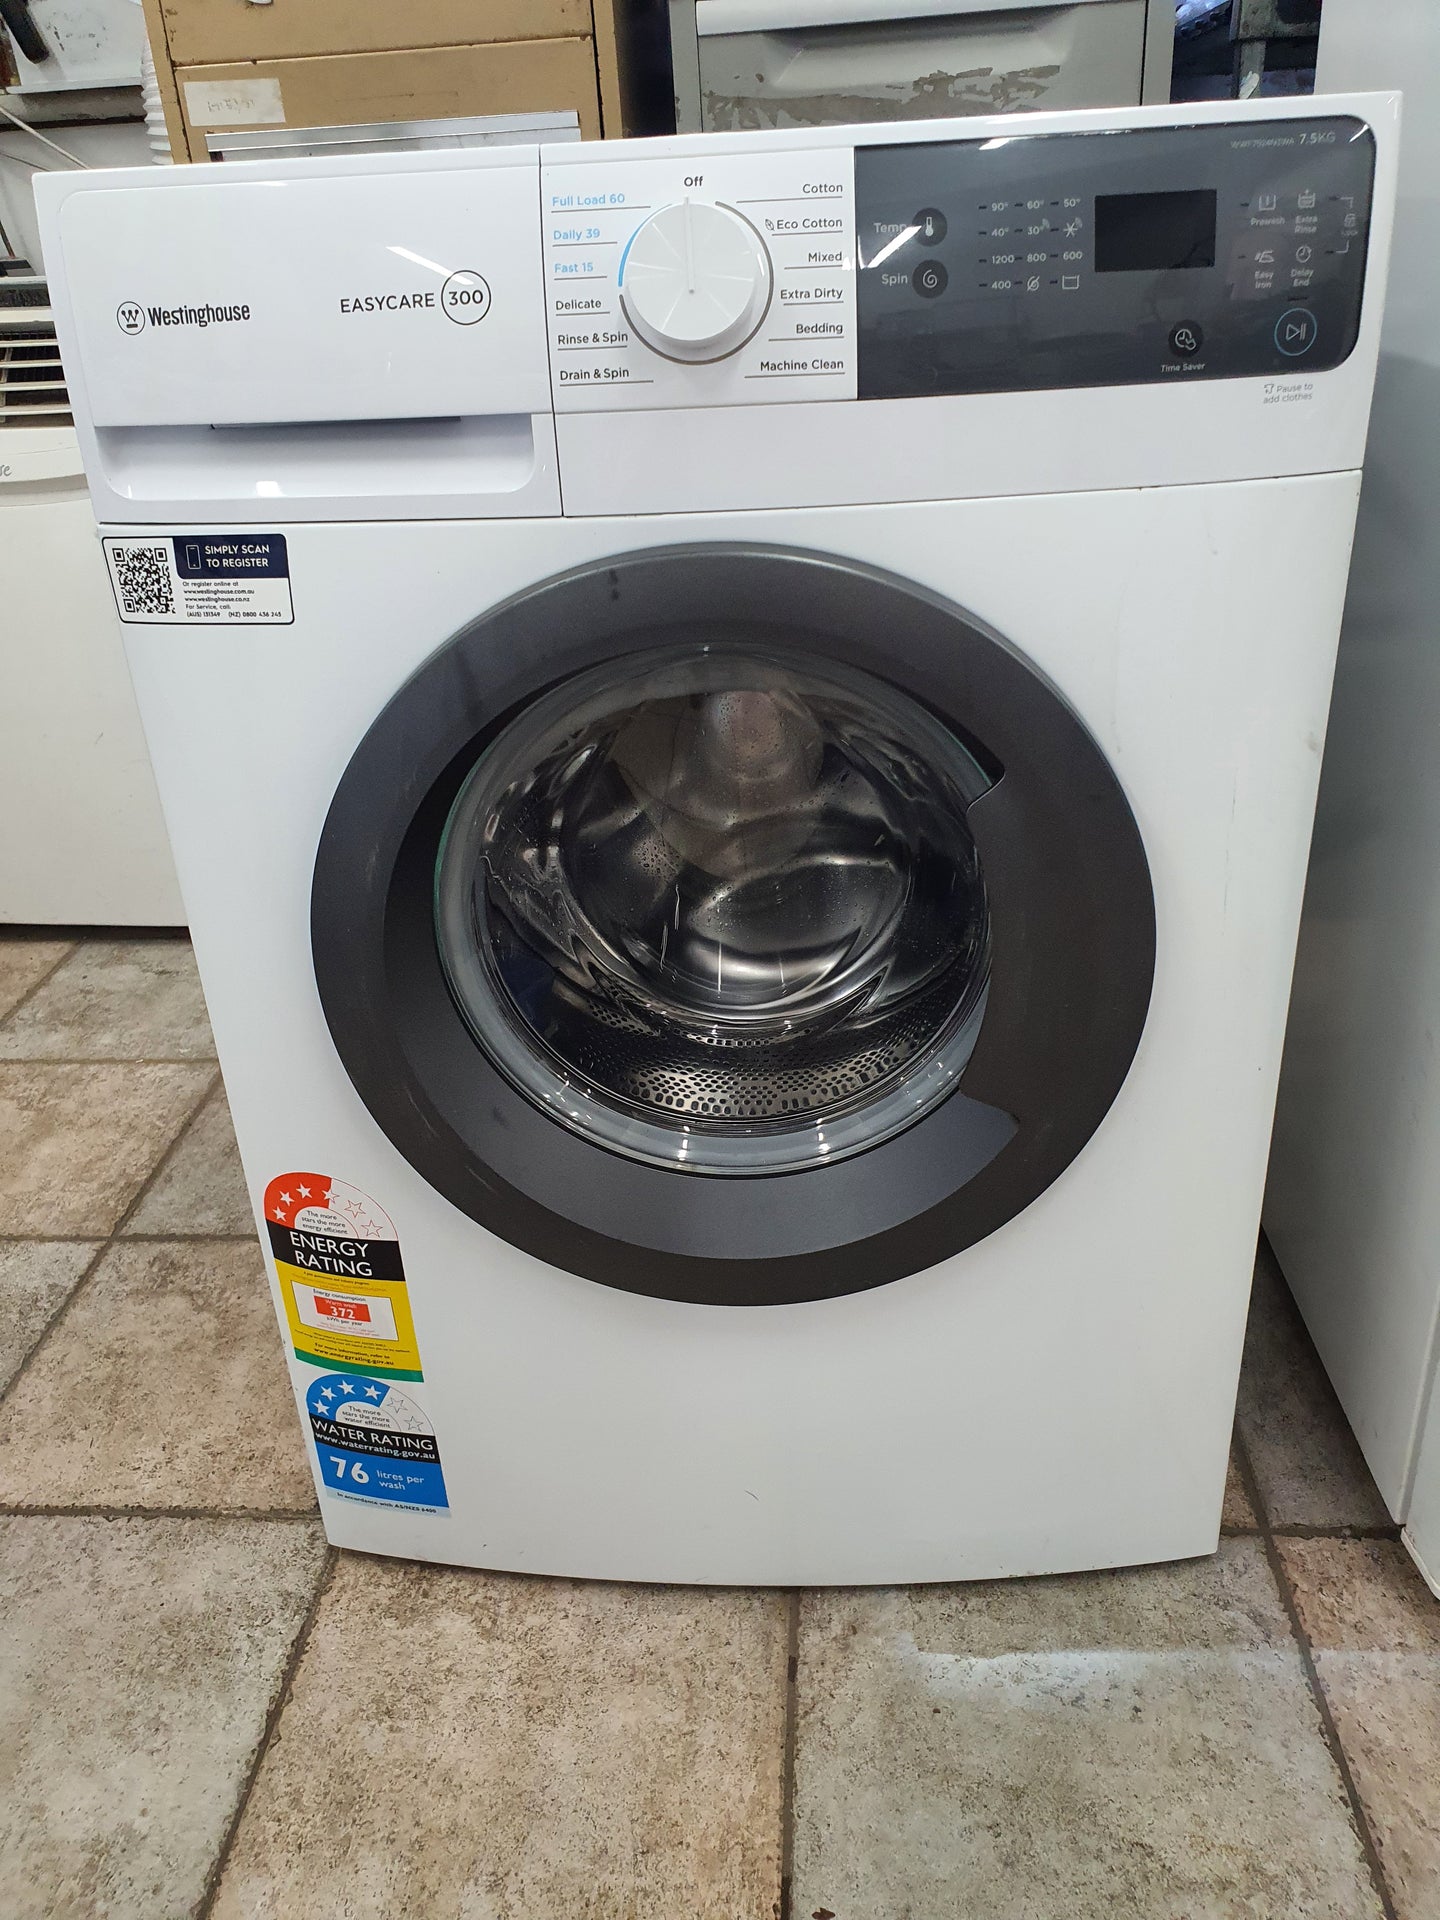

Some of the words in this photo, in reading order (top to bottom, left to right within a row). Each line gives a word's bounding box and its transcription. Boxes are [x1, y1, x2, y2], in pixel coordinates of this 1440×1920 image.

[1299, 131, 1336, 145] 7.5KG
[684, 176, 703, 187] Off
[802, 184, 843, 194] Cotton
[552, 196, 573, 207] Full
[577, 194, 606, 205] Load
[609, 193, 625, 204] 60
[776, 219, 798, 229] Eco
[802, 218, 843, 228] Cotton
[553, 230, 582, 241] Daily
[586, 228, 600, 238] 39
[808, 251, 842, 262] Mixed
[991, 254, 1015, 265] 1200
[1026, 253, 1047, 263] 800
[1063, 251, 1083, 260] 600
[554, 263, 578, 273] Fast
[582, 262, 594, 272] 15
[881, 273, 908, 286] Spin
[991, 280, 1011, 289] 400
[780, 289, 811, 299] Extra
[814, 287, 843, 299] Dirty
[340, 293, 435, 313] EASYCARE
[448, 289, 483, 306] 300
[555, 299, 601, 310] Delicate
[147, 303, 250, 327] Westinghouse
[796, 322, 843, 334] Bedding
[557, 334, 589, 345] Rinse
[592, 333, 600, 343] &
[602, 331, 628, 344] Spin
[760, 360, 808, 371] Machine
[811, 359, 844, 369] Clean
[1160, 363, 1181, 373] Time
[1182, 362, 1206, 372] Saver
[560, 369, 591, 380] Drain
[593, 368, 601, 379] &
[603, 367, 629, 380] Spin
[1276, 384, 1302, 393] Pause
[1304, 383, 1313, 391] to
[1263, 395, 1279, 404] add
[1282, 393, 1313, 402] clothes
[204, 545, 239, 555] SIMPLY
[241, 544, 270, 554] SCAN
[205, 558, 219, 568] TO
[222, 558, 269, 567] REGISTER
[307, 1210, 318, 1218] The
[301, 1216, 316, 1224] stars
[317, 1218, 327, 1226] the
[302, 1223, 322, 1232] energy
[289, 1231, 369, 1258] ENERGY
[295, 1250, 373, 1277] RATING
[313, 1288, 331, 1297] Energy
[330, 1306, 356, 1319] 372
[342, 1410, 358, 1418] stars
[359, 1413, 371, 1421] the
[348, 1405, 361, 1413] The
[362, 1408, 381, 1416] more
[311, 1418, 367, 1442] WATER
[370, 1432, 433, 1451] RATING
[315, 1432, 435, 1459] www.waterrating.gov.au
[329, 1456, 370, 1484] 76
[376, 1469, 403, 1481] litres
[406, 1475, 425, 1484] per
[379, 1480, 406, 1491] wash
